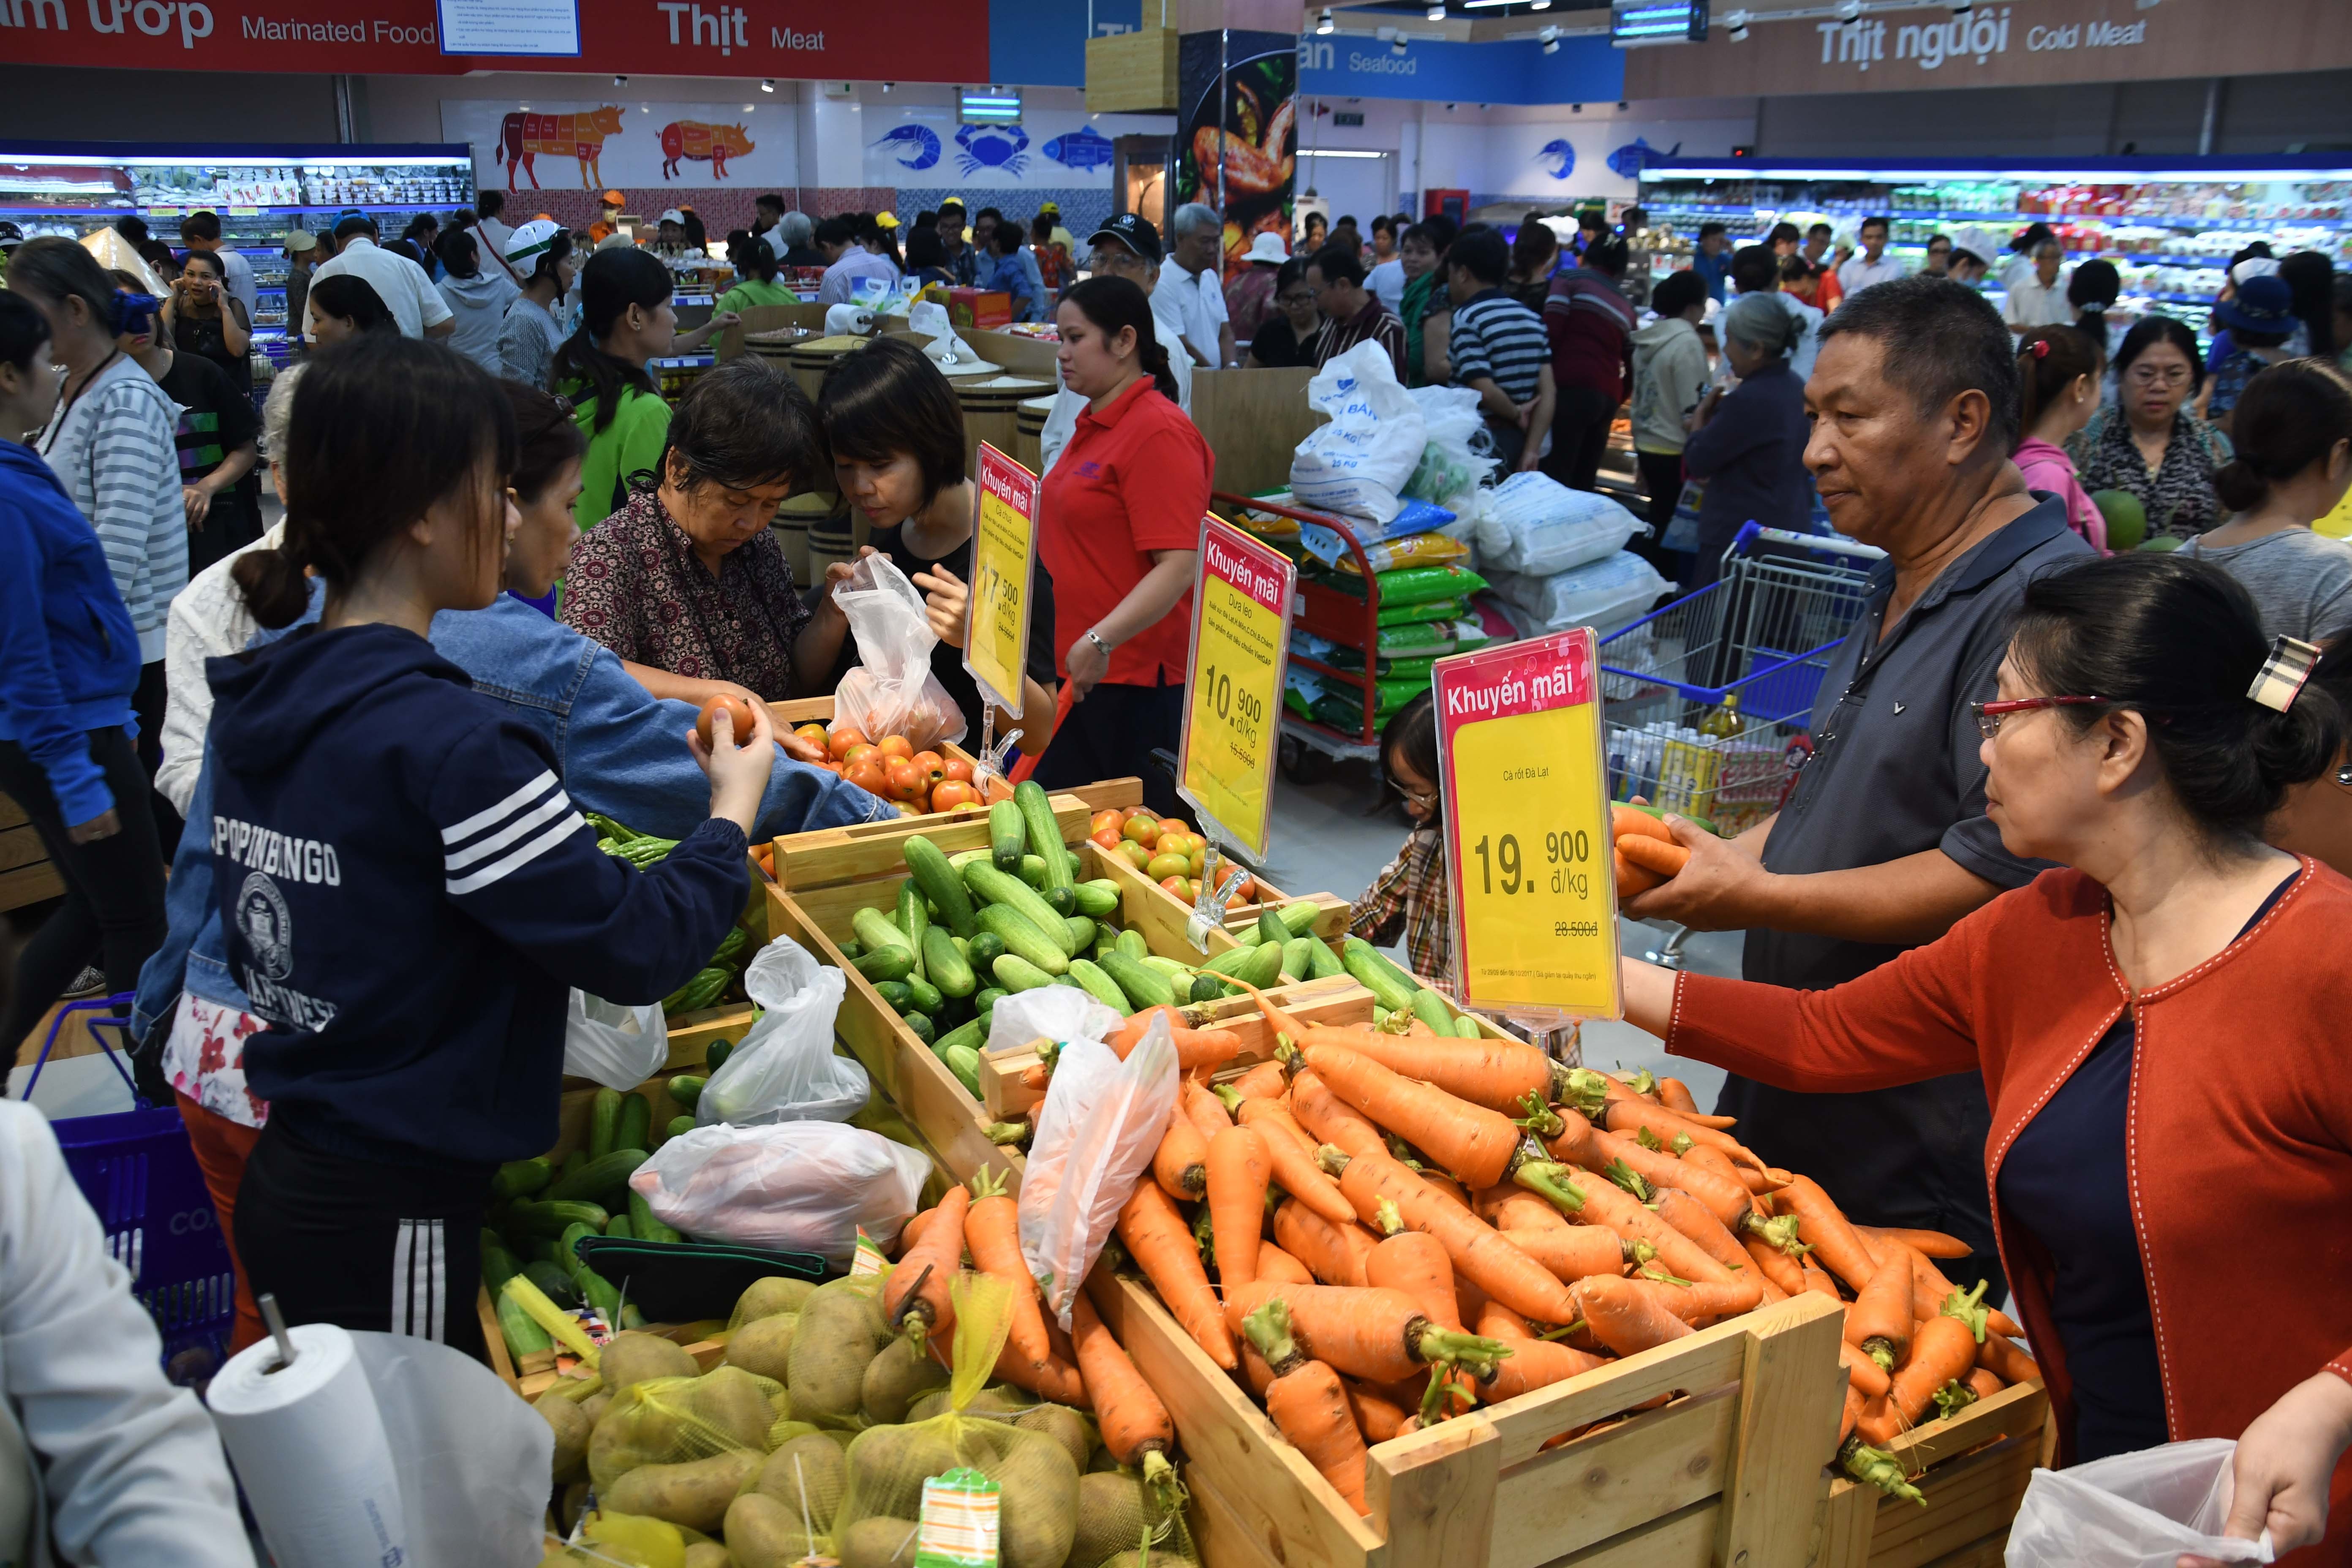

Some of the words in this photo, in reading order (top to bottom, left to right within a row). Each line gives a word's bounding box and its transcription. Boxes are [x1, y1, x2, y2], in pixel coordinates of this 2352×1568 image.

[241, 16, 366, 42] Marinated
[373, 20, 435, 44] Food
[657, 2, 749, 56] Thịt
[771, 27, 825, 51] Meat
[2027, 24, 2078, 52] Cold
[2086, 19, 2147, 48] Meat
[1816, 18, 1886, 71] Thịt
[1348, 52, 1417, 75] Seafood
[982, 465, 1011, 501] Khuyến
[1013, 490, 1028, 512] mãi
[996, 504, 1002, 517] Cà
[1002, 510, 1012, 524] chua
[1207, 540, 1252, 588] Khuyến
[1255, 574, 1279, 605] mãi
[1002, 579, 1018, 606] 500
[1228, 593, 1242, 612] Dưa
[1242, 602, 1252, 619] leo
[1002, 602, 1015, 626] đ/kg
[1448, 670, 1526, 716] Khuyến
[1532, 663, 1573, 700] mãi
[1237, 688, 1261, 723] 900
[1237, 716, 1257, 749] đ/kg
[1503, 770, 1514, 781] Cà
[1515, 767, 1524, 780] rốt
[1525, 767, 1536, 779] Đà
[1538, 766, 1549, 779] Lạt
[1475, 834, 1535, 895] 19.
[1546, 830, 1589, 864] 900
[1551, 867, 1588, 900] đ/kg
[1555, 921, 1598, 937] 28.500đ
[170, 1207, 218, 1235] CO.
